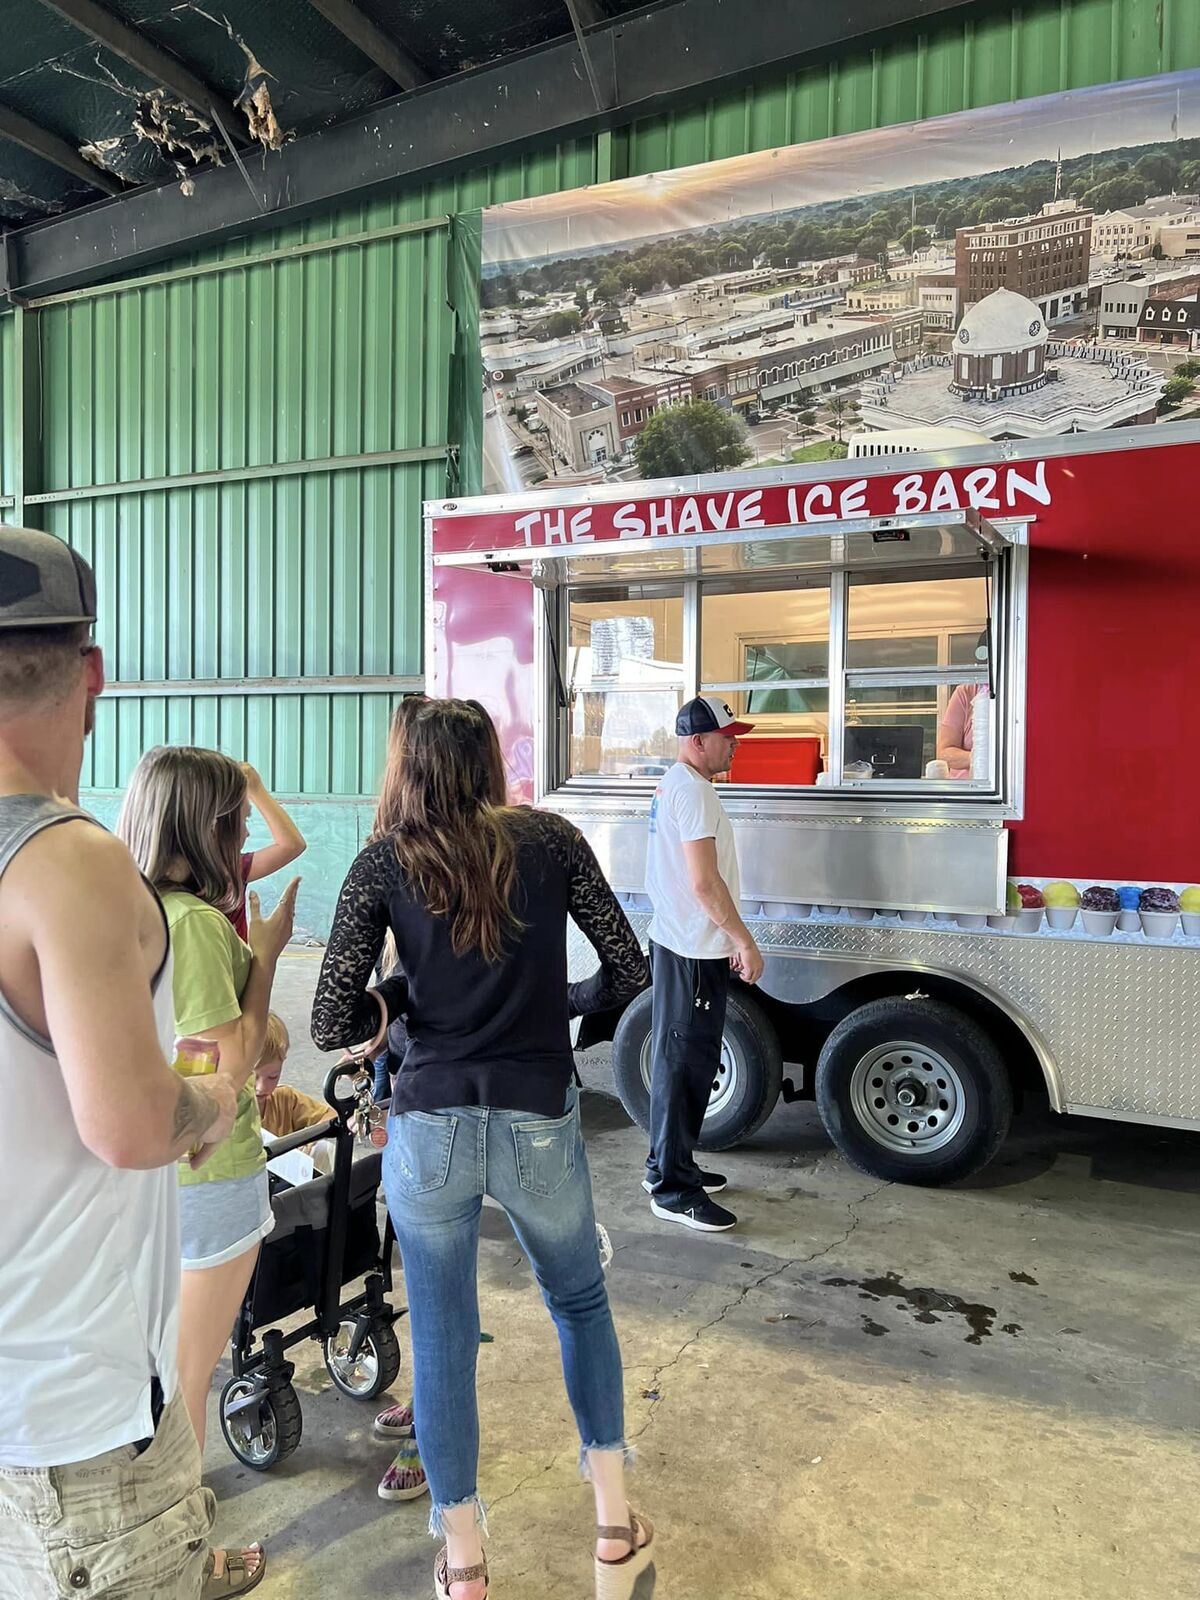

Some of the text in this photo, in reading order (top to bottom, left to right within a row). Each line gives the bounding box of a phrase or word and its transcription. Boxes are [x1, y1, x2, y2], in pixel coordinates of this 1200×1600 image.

[514, 461, 1051, 547] THE SHAVE ICE BARN
